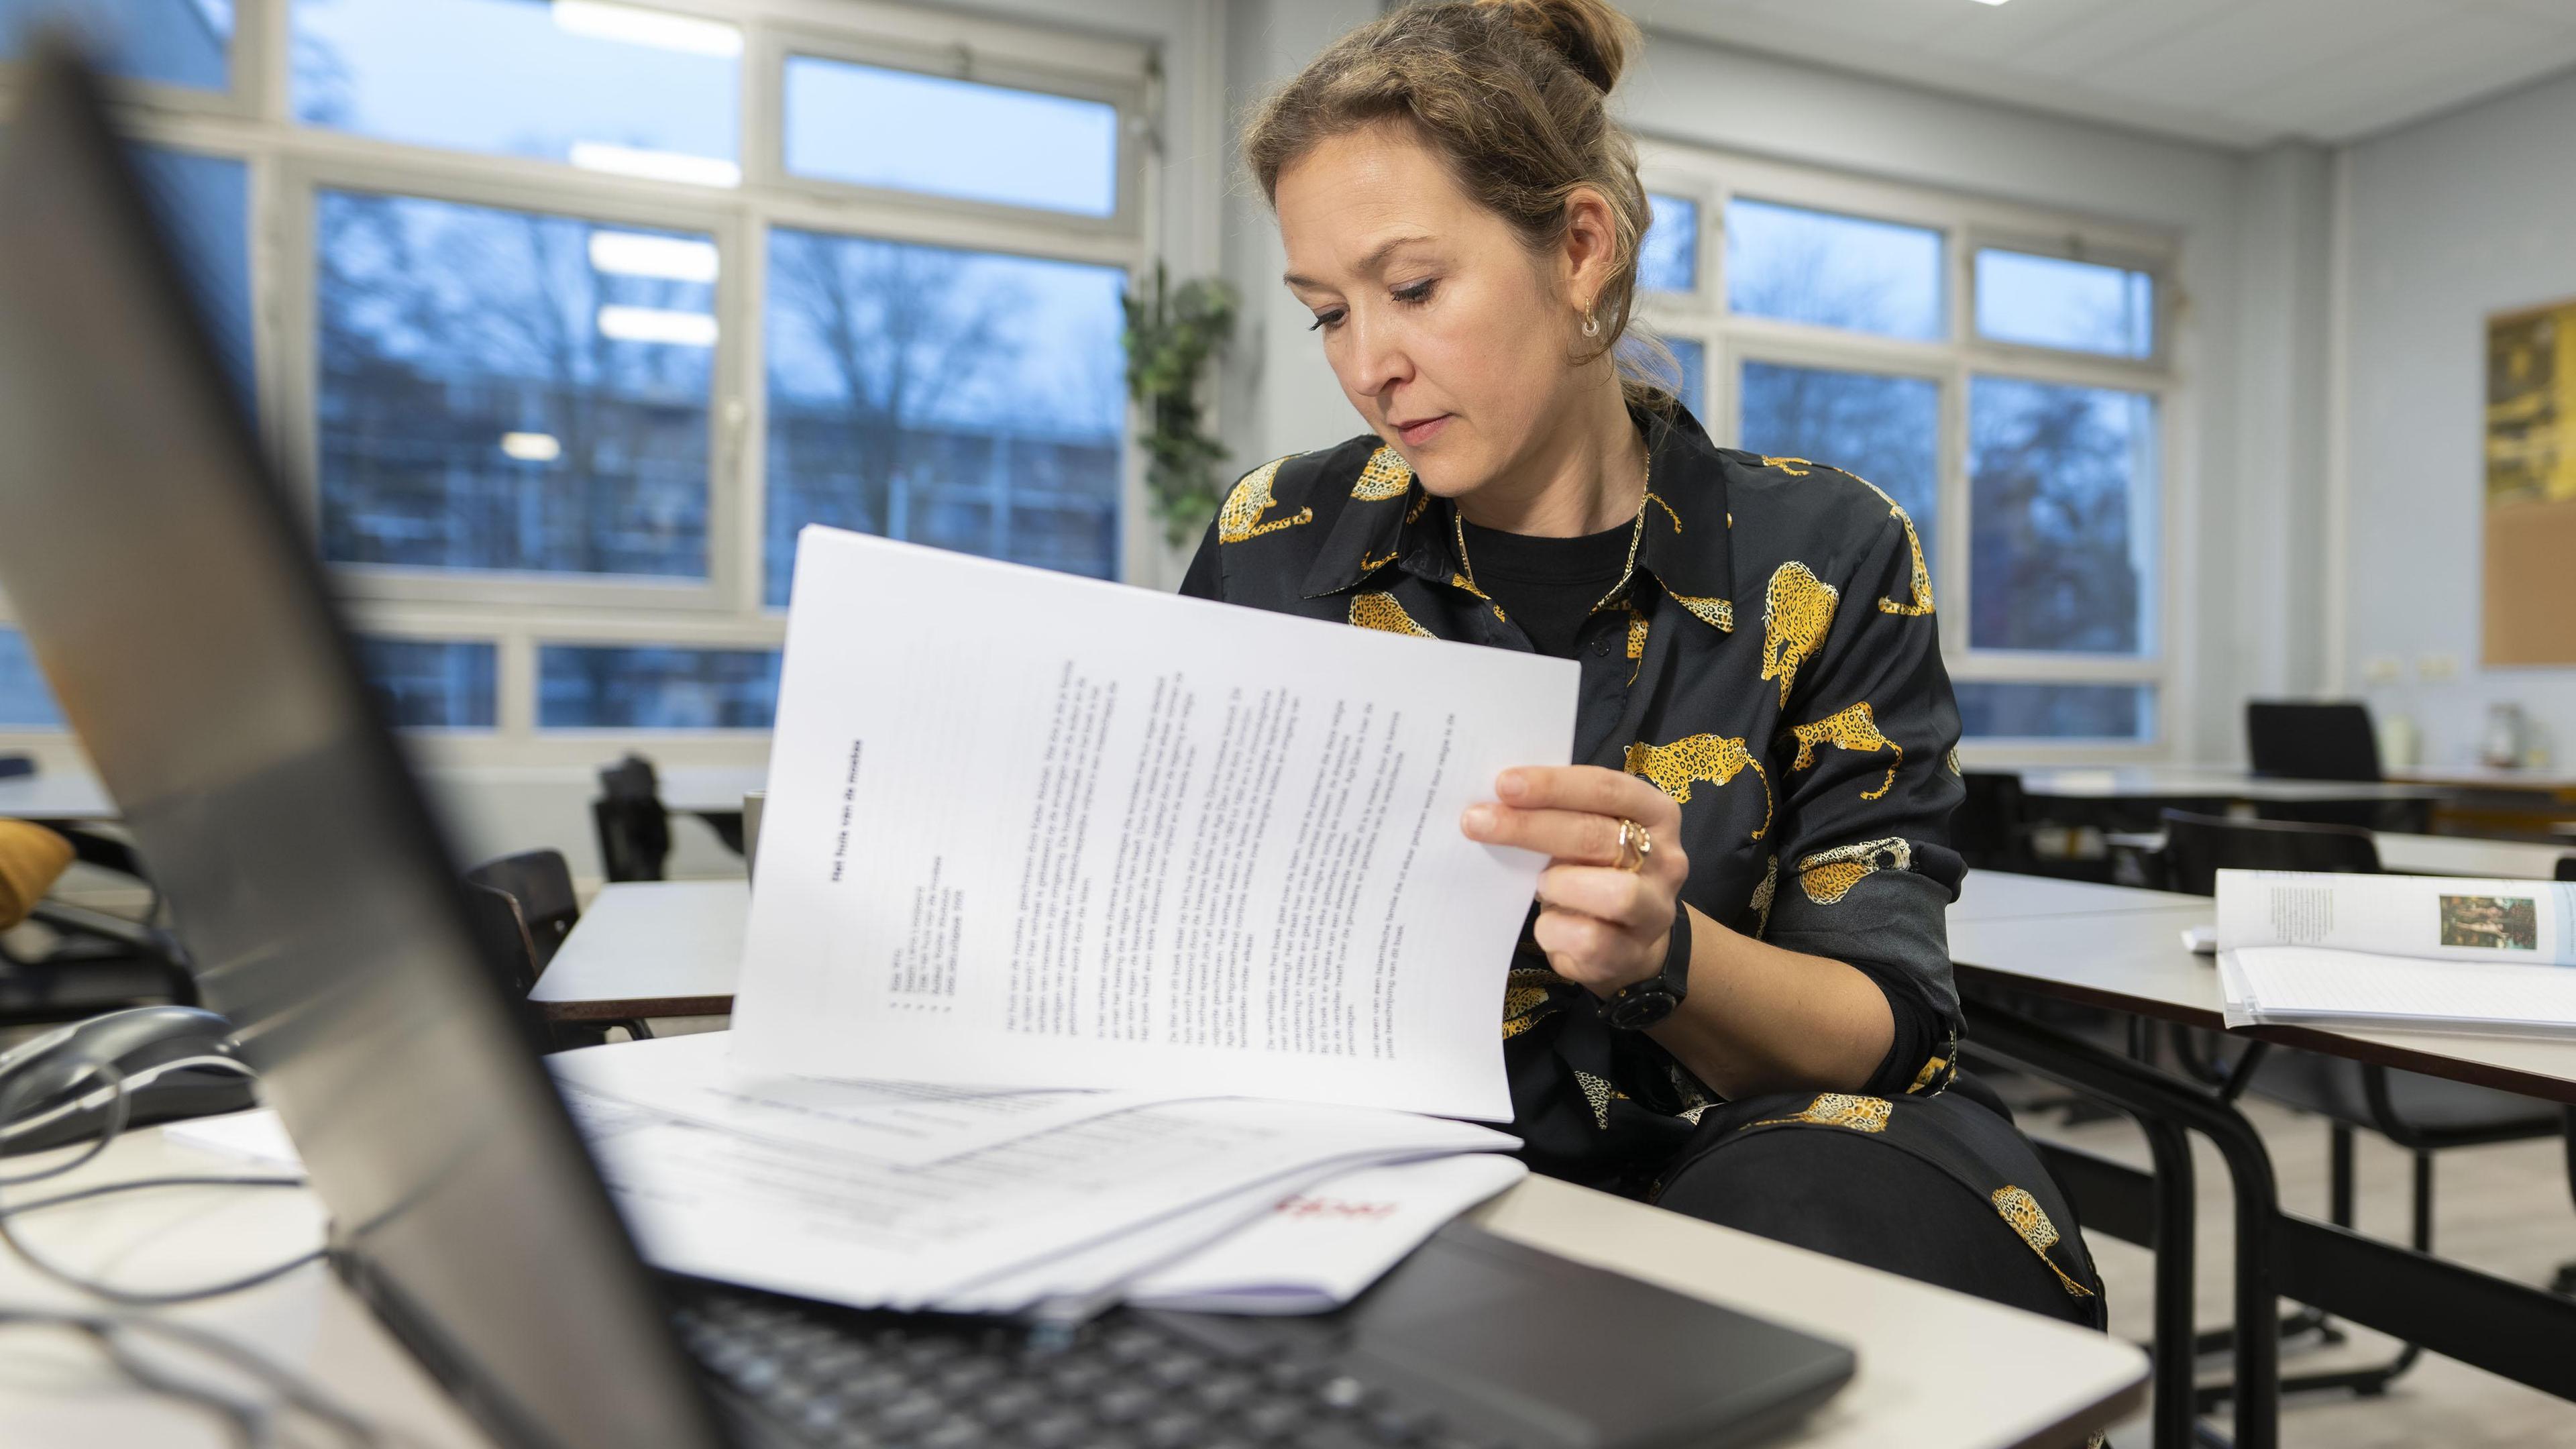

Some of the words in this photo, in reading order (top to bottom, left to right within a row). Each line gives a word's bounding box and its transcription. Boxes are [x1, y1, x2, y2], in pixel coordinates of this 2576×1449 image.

[844, 786, 855, 800] de
[842, 804, 852, 825] van
[835, 830, 849, 856] huis
[831, 860, 843, 881] Het
